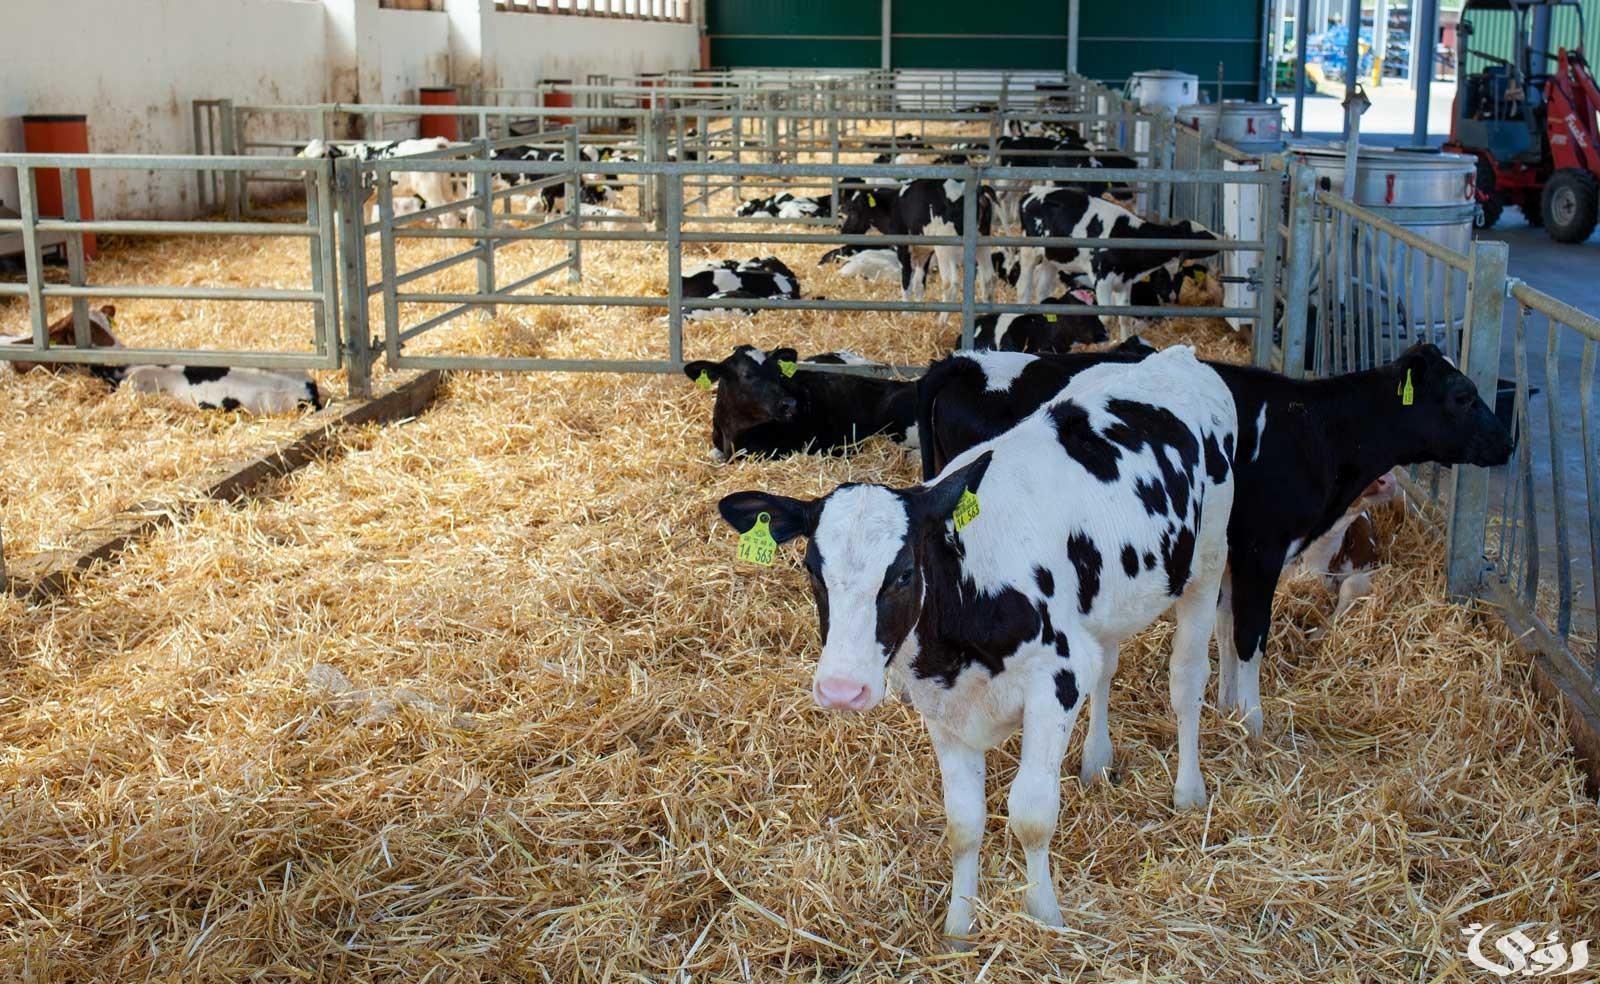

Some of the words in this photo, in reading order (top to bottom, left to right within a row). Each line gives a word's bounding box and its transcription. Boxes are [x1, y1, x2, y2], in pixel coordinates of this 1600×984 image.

[967, 504, 979, 521] 563
[740, 543, 751, 559] 14
[756, 546, 773, 564] 563
